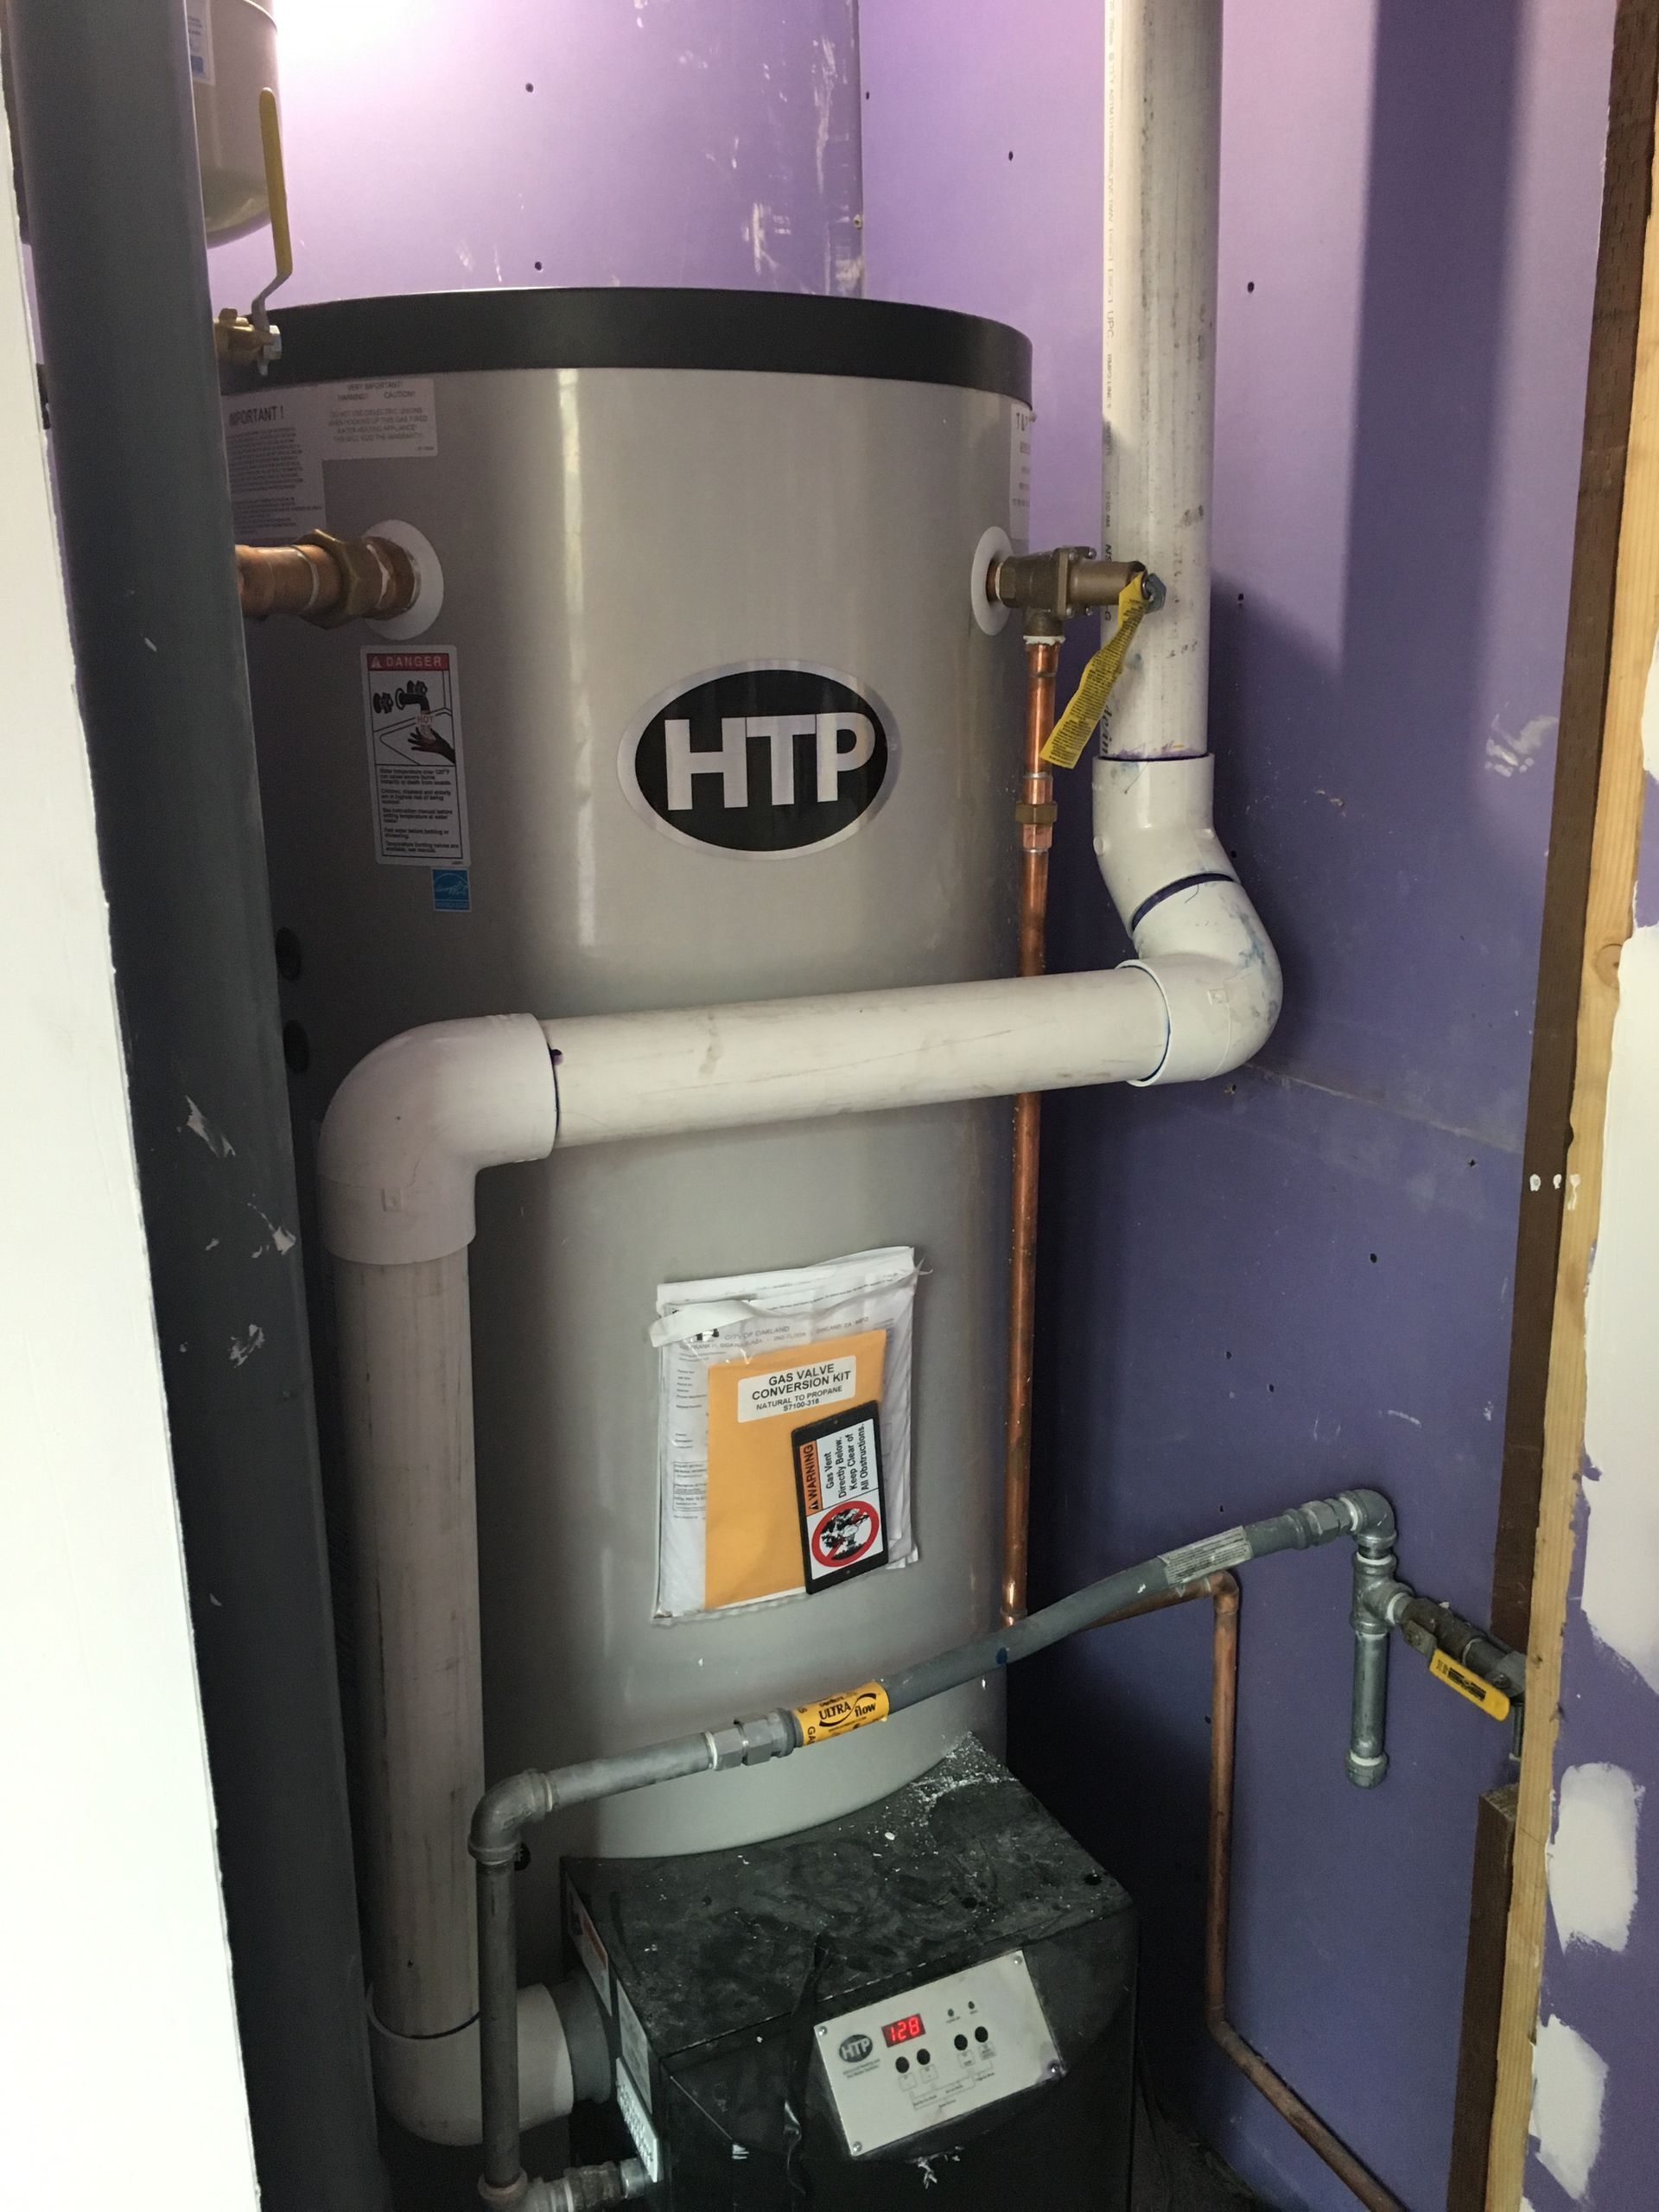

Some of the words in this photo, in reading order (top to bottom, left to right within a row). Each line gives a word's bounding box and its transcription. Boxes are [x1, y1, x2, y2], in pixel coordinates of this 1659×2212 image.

[1106, 310, 1116, 338] UPC
[385, 656, 442, 667] DANGER
[664, 711, 875, 810] HTP
[752, 1375, 830, 1401] CONVERSION
[832, 1370, 852, 1383] KIT
[768, 1372, 794, 1387] GAS
[796, 1363, 836, 1381] VALVE
[755, 1397, 793, 1411] NATURAL
[794, 1394, 805, 1402] TO
[805, 1385, 843, 1400] PROPANE
[844, 1433, 855, 1444] of
[823, 1452, 834, 1472] Vent
[834, 1436, 844, 1465] Below.
[845, 1445, 855, 1467] Clear
[856, 1423, 869, 1478] Obstructions.
[803, 1444, 817, 1501] WARNING
[825, 1471, 835, 1490] Gas
[836, 1465, 847, 1499] Directly
[849, 1468, 859, 1491] Keep
[860, 1479, 870, 1491] All
[818, 1701, 851, 1719] ULTRA
[855, 1703, 876, 1717] flow
[890, 2017, 920, 2042] 128
[841, 2037, 870, 2060] HTP
